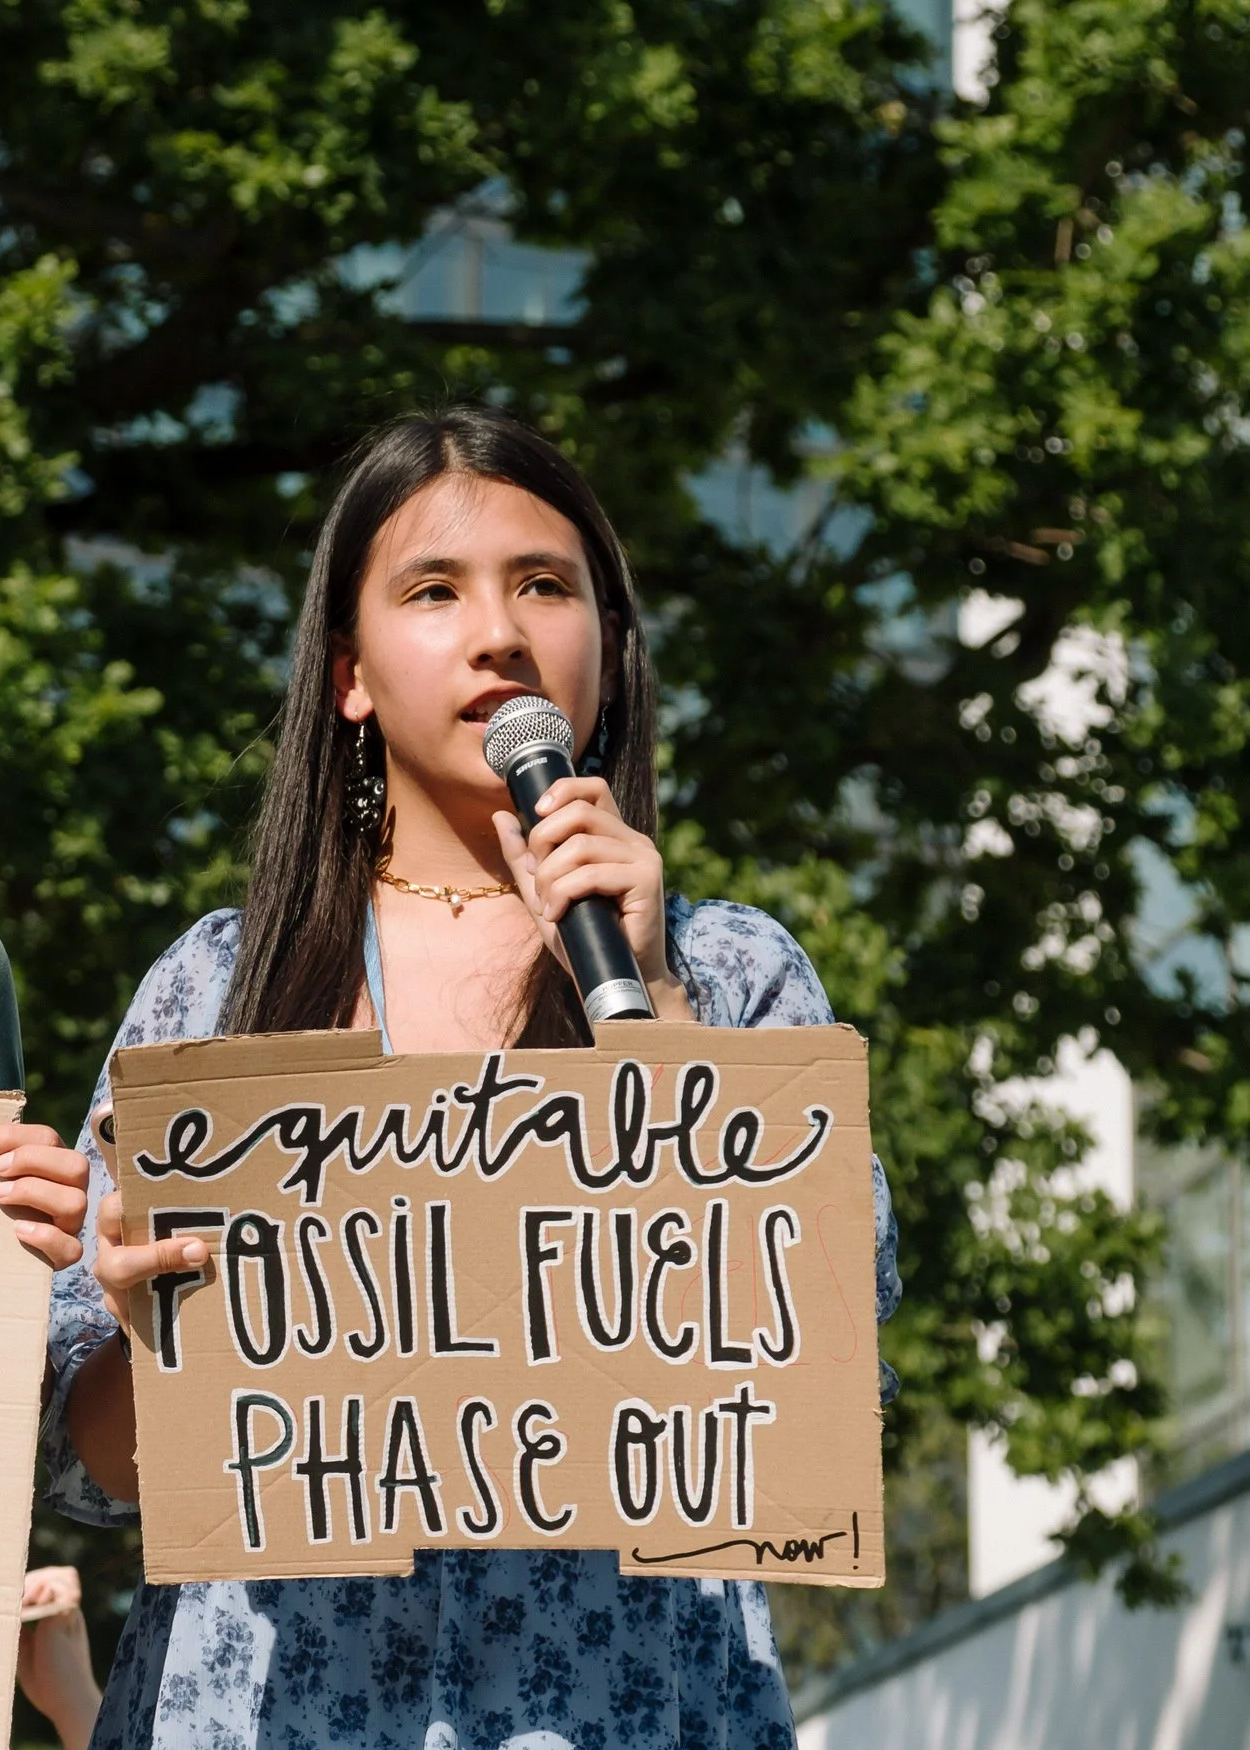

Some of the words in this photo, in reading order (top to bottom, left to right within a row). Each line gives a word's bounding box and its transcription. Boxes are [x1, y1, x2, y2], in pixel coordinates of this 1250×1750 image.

[133, 1052, 833, 1205] equitable
[520, 1198, 801, 1370] FUELS
[224, 1388, 577, 1552] PHASE
[609, 1380, 776, 1532] OUT
